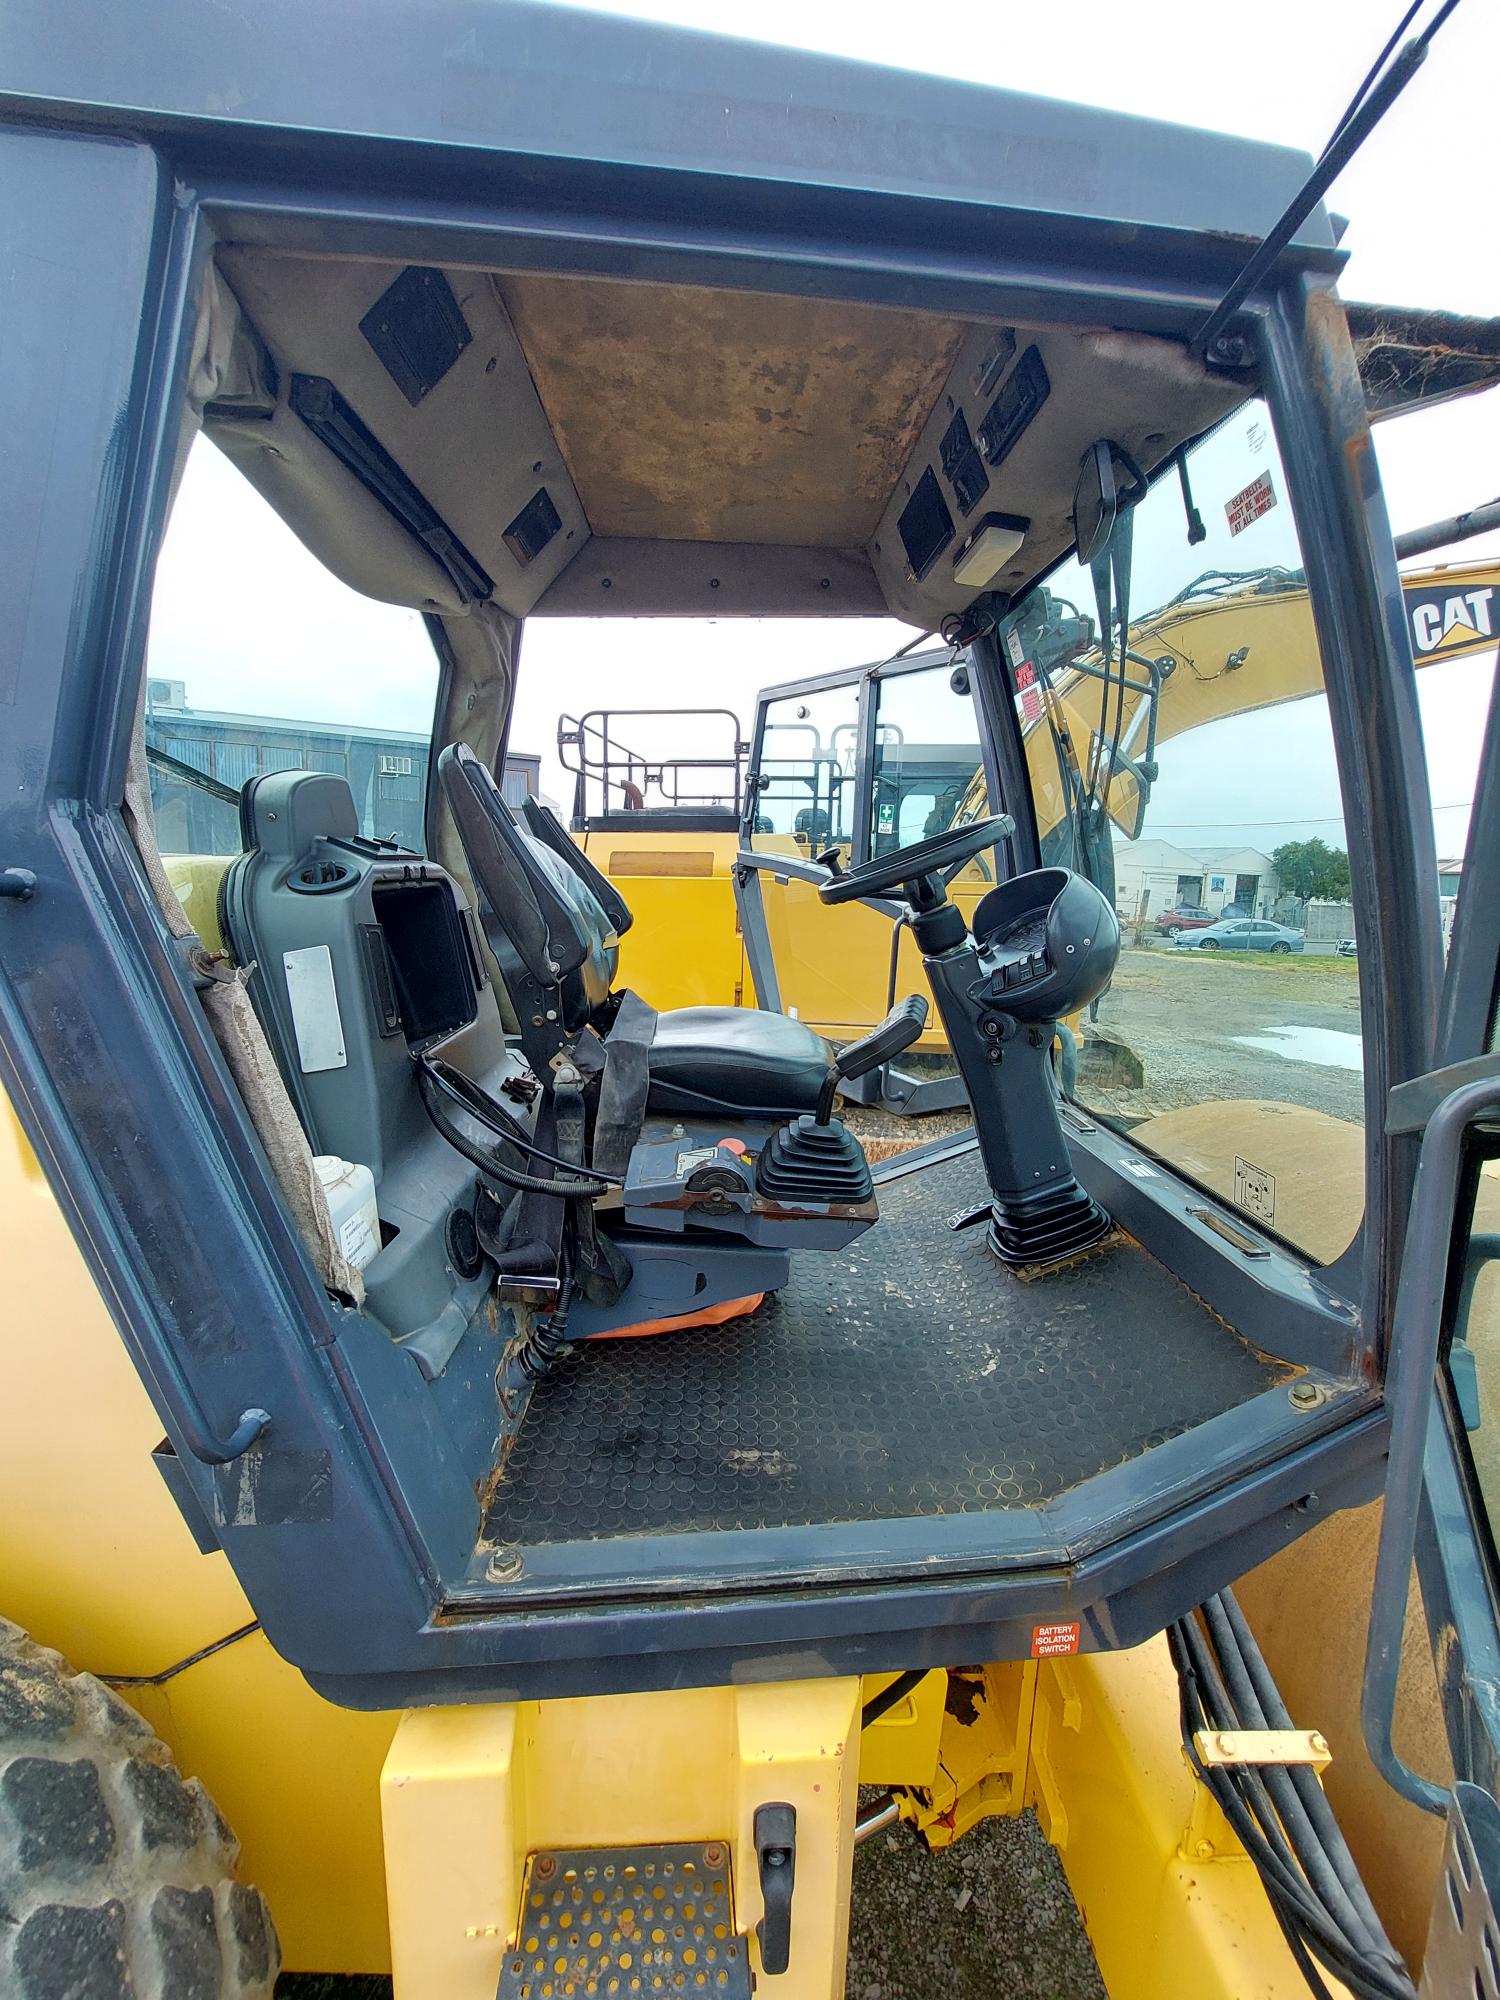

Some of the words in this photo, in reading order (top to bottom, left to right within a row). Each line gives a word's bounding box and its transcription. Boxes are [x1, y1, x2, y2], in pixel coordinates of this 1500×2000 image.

[1228, 506, 1244, 524] MUST
[1245, 499, 1253, 512] BE
[1253, 484, 1272, 504] WORN
[1232, 479, 1263, 509] SEATBELTS
[1234, 521, 1241, 533] AT
[1243, 513, 1253, 525] ALL
[1253, 498, 1271, 517] TIMES
[1412, 588, 1493, 651] CAT
[1035, 1634, 1076, 1645] ISOLATION
[1039, 1625, 1073, 1636] BATTERY
[1039, 1644, 1071, 1654] SWITCH
